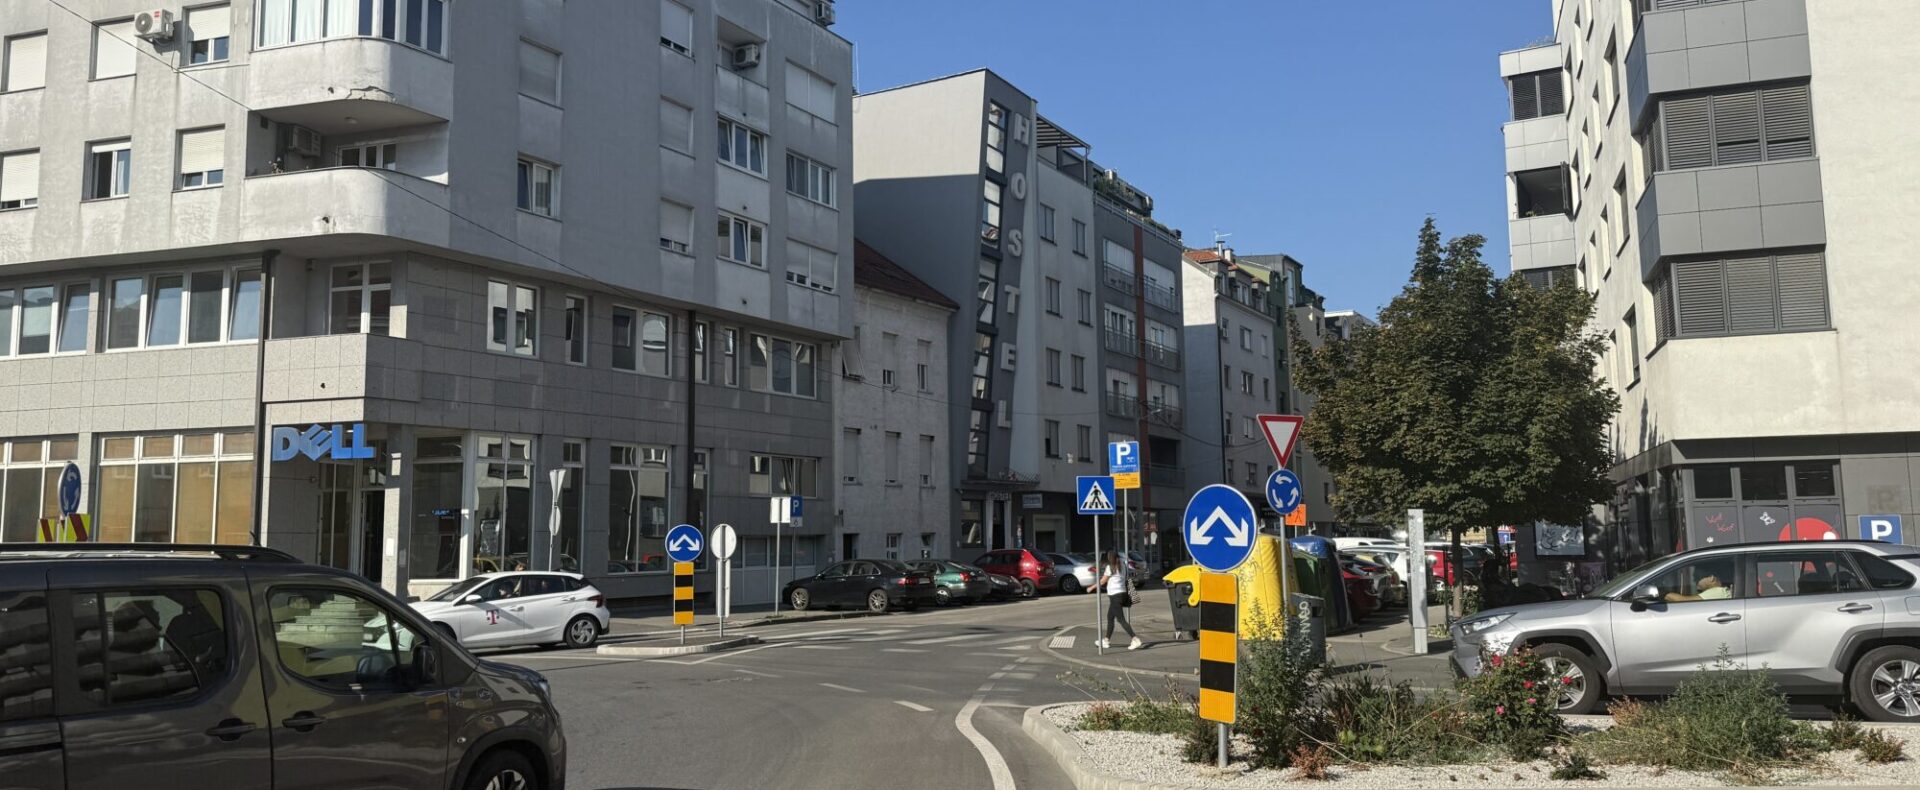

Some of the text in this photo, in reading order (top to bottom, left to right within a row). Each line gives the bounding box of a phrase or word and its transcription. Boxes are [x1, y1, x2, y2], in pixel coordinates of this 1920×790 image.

[997, 113, 1030, 428] HOSTEL
[272, 423, 376, 461] DELL
[1116, 443, 1131, 465] P
[793, 499, 800, 513] P
[1871, 519, 1893, 540] P
[486, 609, 500, 625] T
